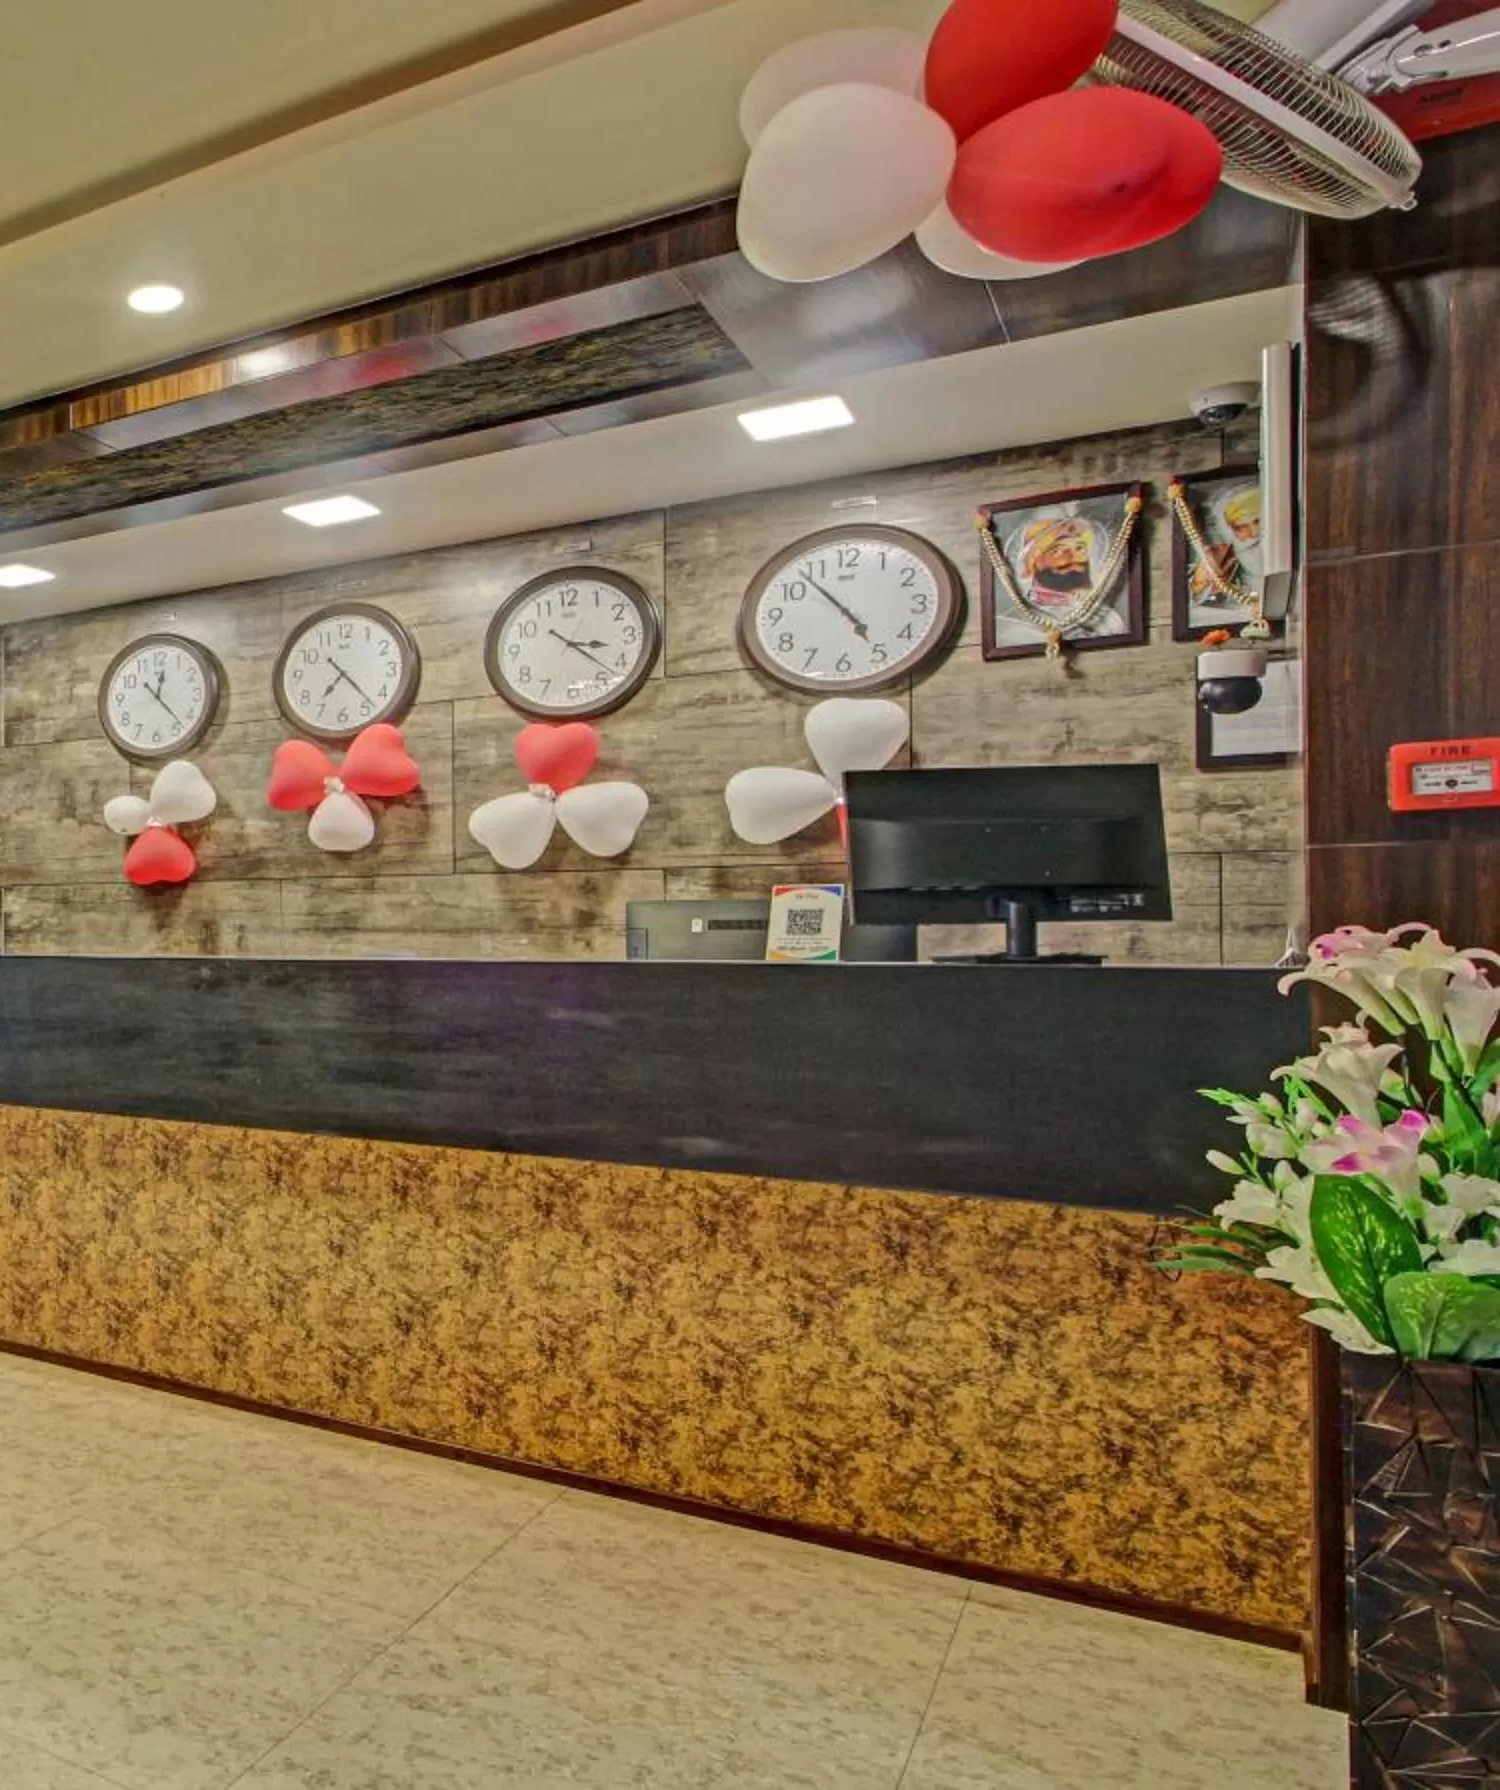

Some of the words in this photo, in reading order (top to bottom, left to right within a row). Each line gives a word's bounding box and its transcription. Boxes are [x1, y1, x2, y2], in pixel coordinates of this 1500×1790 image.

[837, 548, 860, 569] 12
[879, 551, 886, 571] 1
[806, 559, 826, 580] 11
[900, 567, 917, 588] 2
[559, 588, 579, 608] 12
[781, 581, 807, 603] 10
[536, 600, 551, 618] 11
[611, 603, 626, 622] 2
[910, 594, 928, 615] 3
[768, 607, 783, 627] 9
[517, 619, 537, 639] 10
[623, 625, 637, 645] 3
[896, 622, 912, 641] 4
[378, 639, 389, 656] 2
[507, 643, 520, 662] 9
[778, 632, 794, 653] 8
[301, 648, 319, 665] 10
[614, 651, 627, 669] 4
[803, 647, 819, 671] 7
[835, 652, 852, 673] 6
[870, 643, 888, 664] 5
[386, 661, 397, 678] 3
[519, 666, 532, 683] 8
[377, 684, 388, 700] 4
[539, 678, 552, 698] 7
[316, 703, 327, 719] 7
[338, 707, 349, 722] 6
[360, 702, 371, 717] 5
